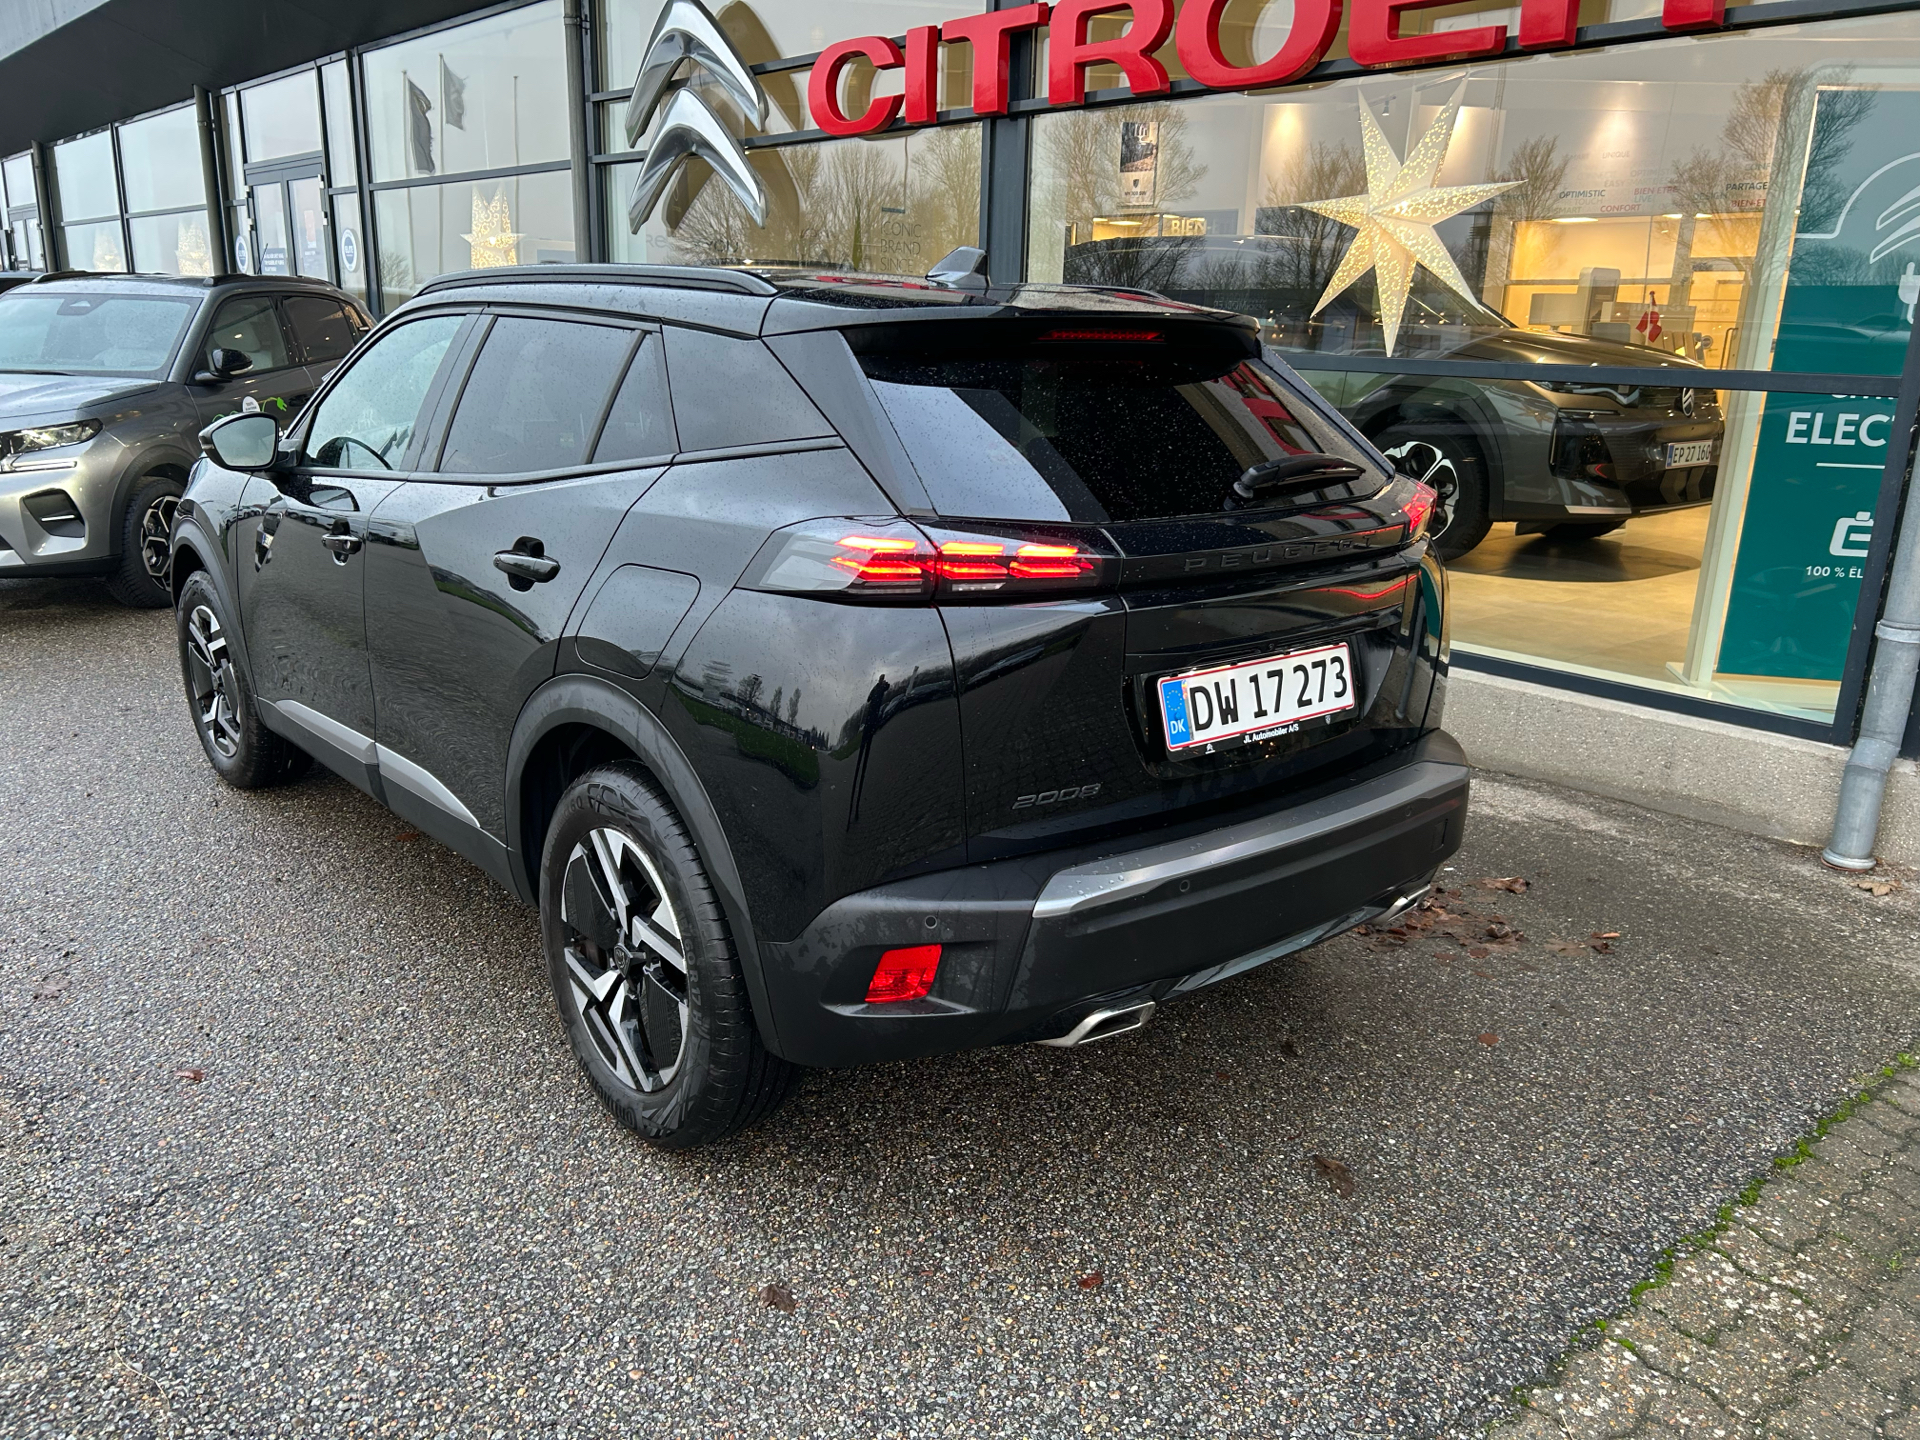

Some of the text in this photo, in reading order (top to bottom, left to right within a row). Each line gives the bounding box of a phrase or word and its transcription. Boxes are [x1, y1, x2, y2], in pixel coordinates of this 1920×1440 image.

[1559, 189, 1606, 199] OPTIMISTIC
[1634, 187, 1654, 196] BIEN
[1726, 182, 1768, 191] PARTAGE
[1600, 204, 1642, 213] CONFORT
[881, 221, 922, 238] ICONIC
[881, 238, 921, 255] BRAND
[880, 256, 914, 273] SINCE
[1785, 411, 1895, 447] ELEC
[1673, 447, 1685, 463] EP
[1685, 446, 1696, 462] 27
[1805, 565, 1831, 577] 100
[1834, 566, 1845, 578] %
[1189, 655, 1348, 732] DW 17 273
[1169, 718, 1186, 735] DK
[1243, 723, 1300, 744] JL Automobiler A/S
[1012, 783, 1102, 810] 2008
[691, 986, 702, 1006] 17
